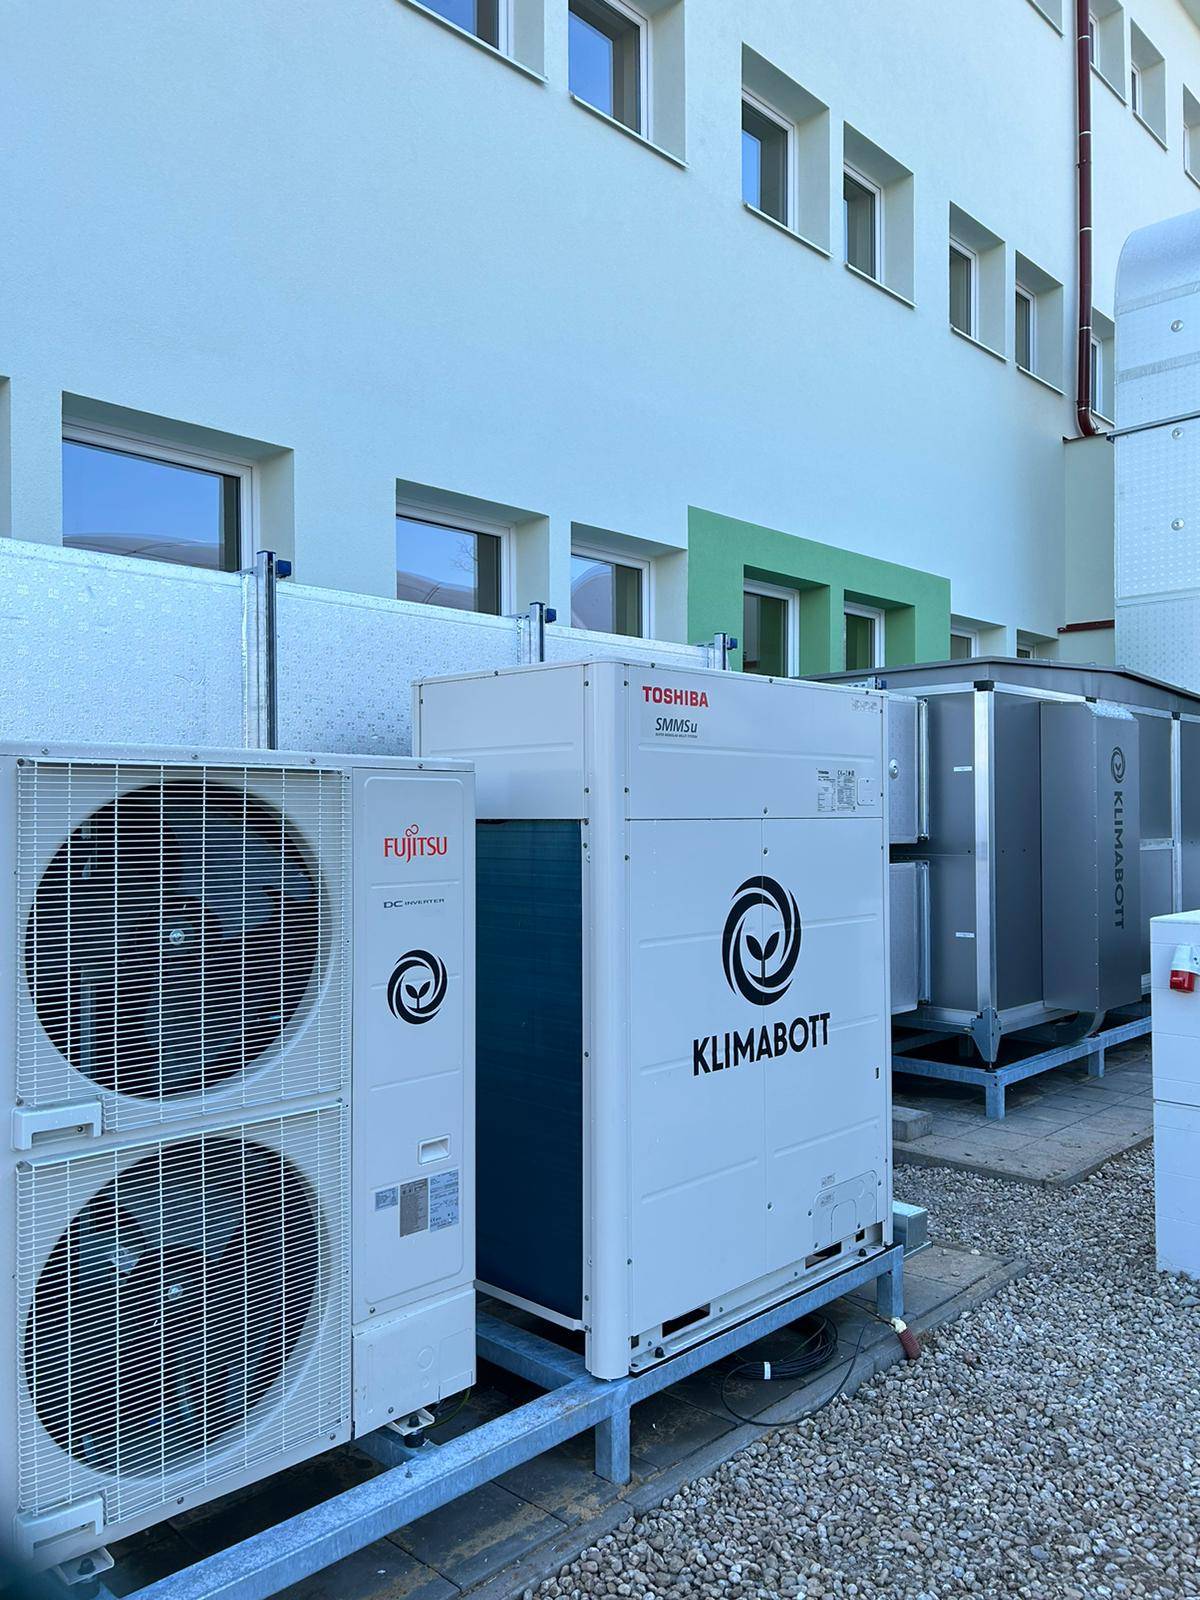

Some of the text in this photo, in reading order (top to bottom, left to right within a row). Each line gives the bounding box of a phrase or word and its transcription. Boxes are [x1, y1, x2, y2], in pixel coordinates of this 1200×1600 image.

[642, 686, 709, 708] TOSHIBA
[655, 717, 698, 733] SMMSu
[384, 824, 448, 864] FUJITSU
[1114, 791, 1125, 930] KLIMABOTT
[383, 898, 445, 909] DC INVERTER
[693, 1012, 831, 1077] KLIMABOTT
